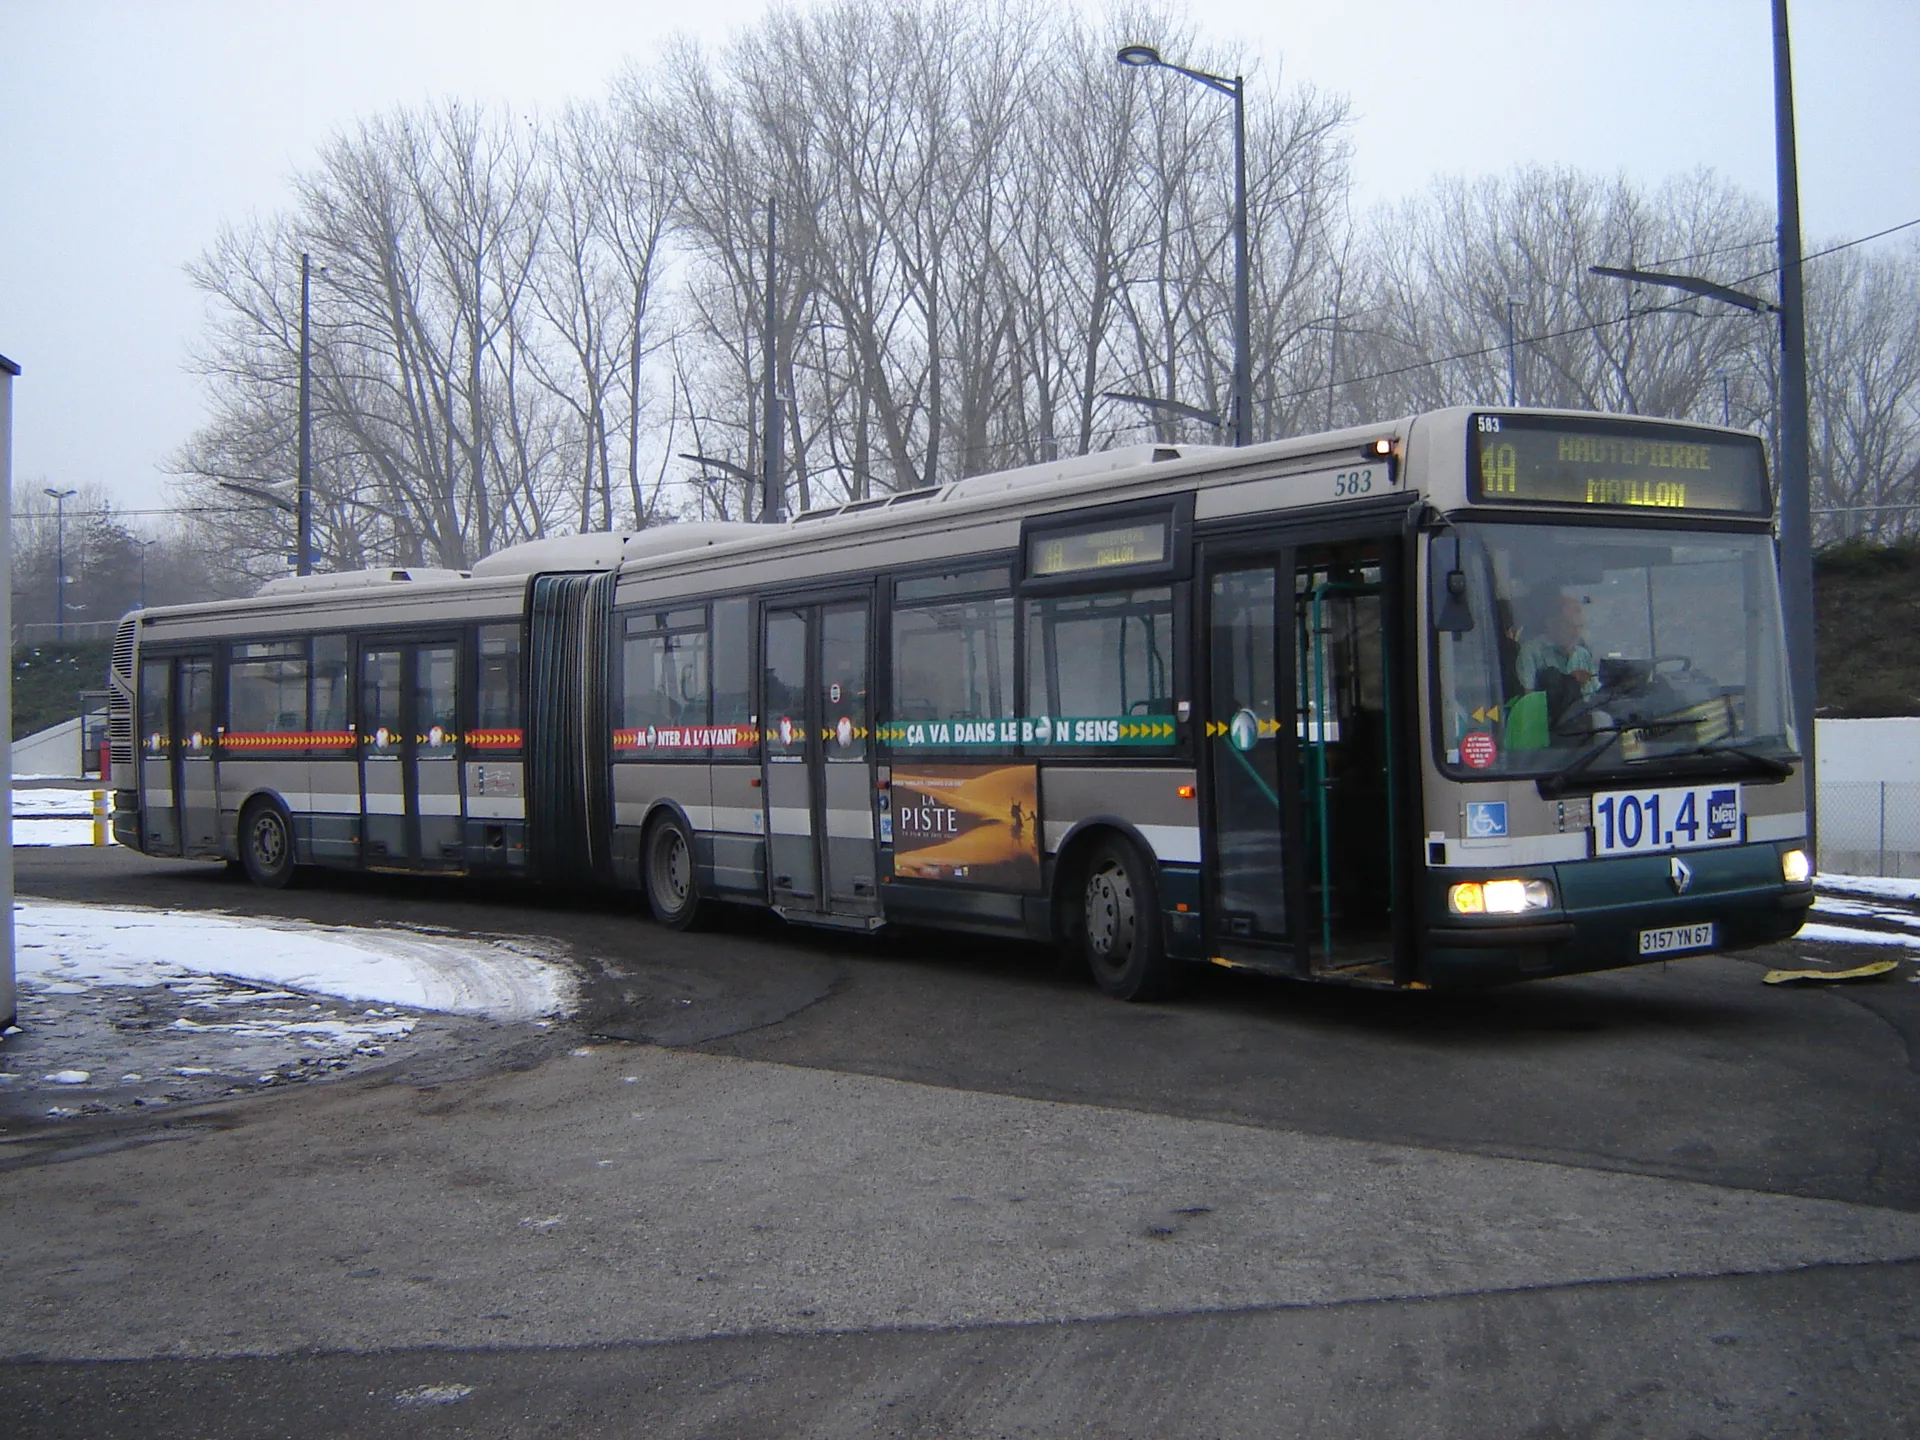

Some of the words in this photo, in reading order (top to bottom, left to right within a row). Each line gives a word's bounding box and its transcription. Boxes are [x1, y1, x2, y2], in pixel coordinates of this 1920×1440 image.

[1477, 416, 1500, 433] 583
[1481, 442, 1516, 492] 4A
[1335, 470, 1371, 496] 583
[694, 729, 737, 746] L'AVANT
[906, 721, 925, 746] ÇA
[930, 723, 950, 743] VA
[955, 722, 995, 743] DANS
[1000, 721, 1017, 742] LE
[1075, 720, 1119, 742] SENS
[922, 795, 935, 806] LA
[901, 807, 958, 832] PISTE
[1597, 792, 1699, 849] 101.4
[1712, 806, 1736, 823] bleu
[1643, 931, 1673, 950] 3157
[1677, 928, 1692, 946] YN
[1695, 926, 1709, 944] 67
